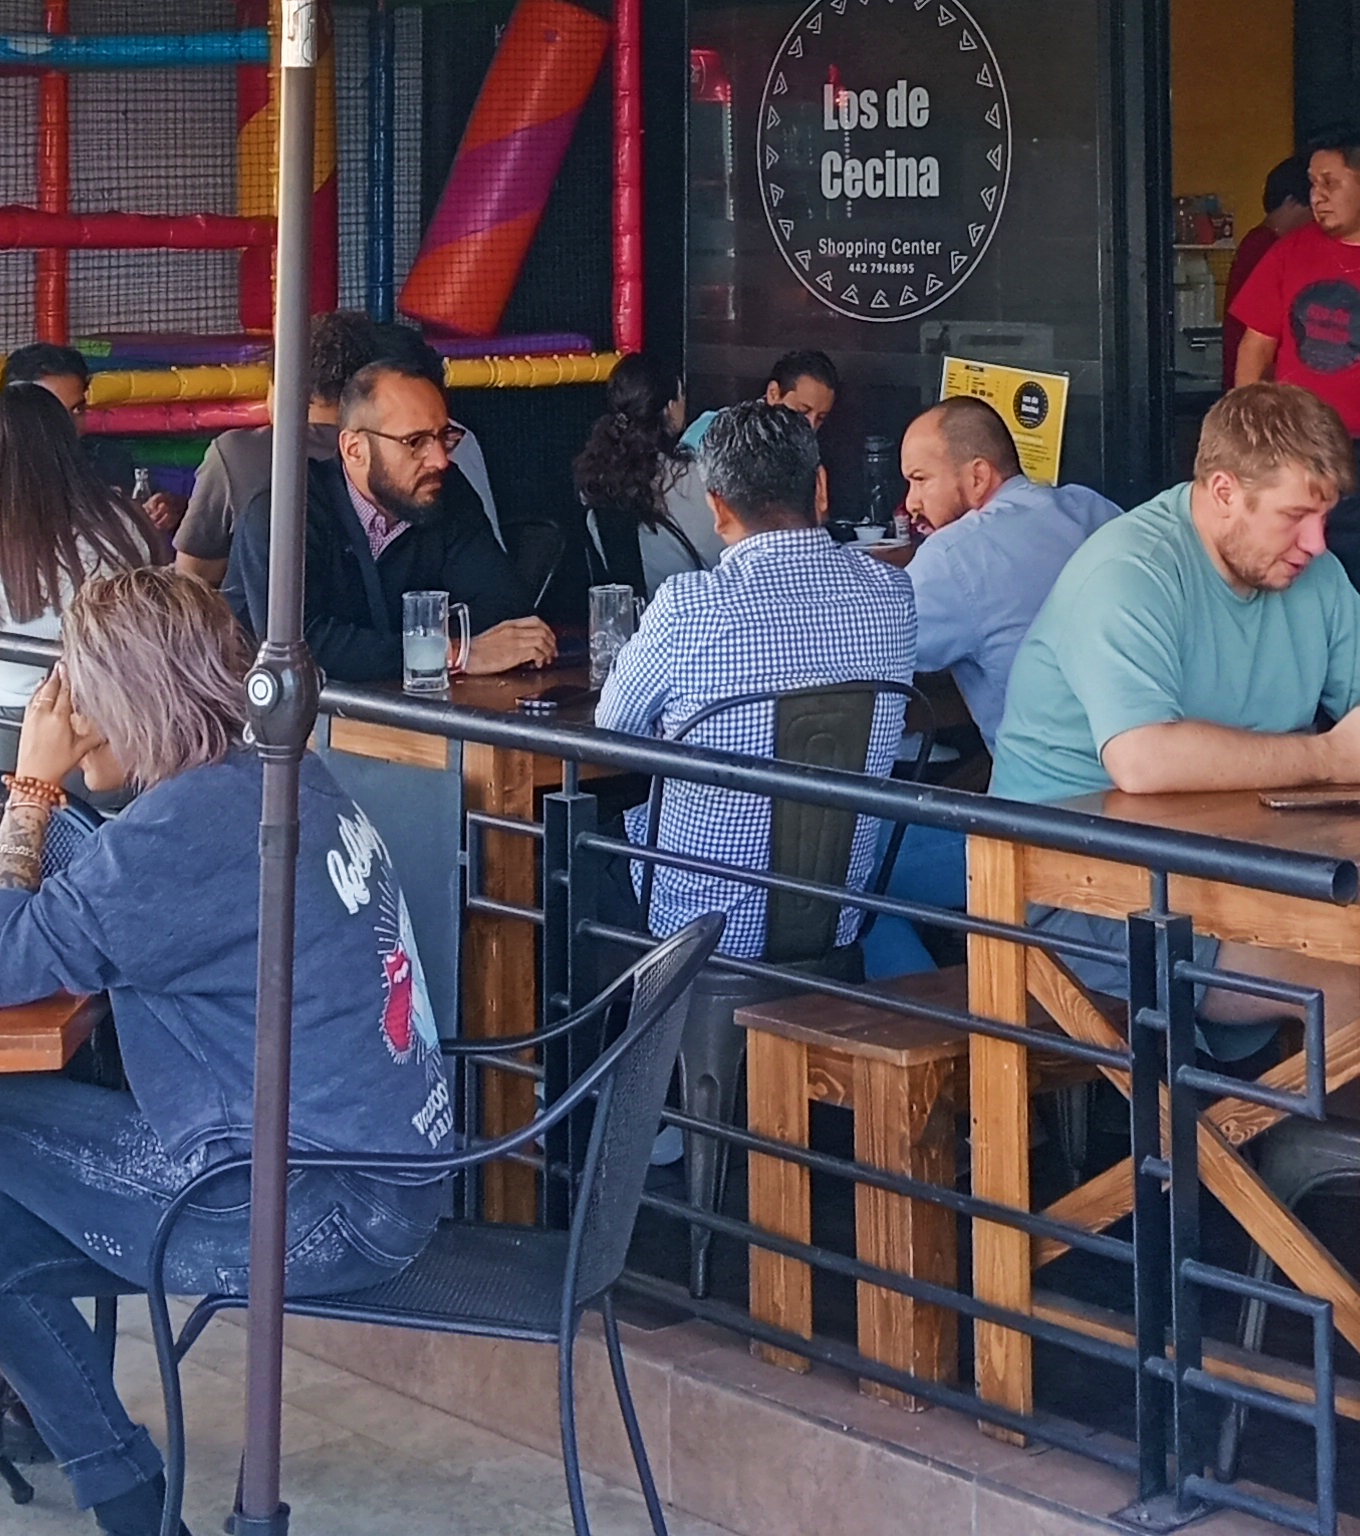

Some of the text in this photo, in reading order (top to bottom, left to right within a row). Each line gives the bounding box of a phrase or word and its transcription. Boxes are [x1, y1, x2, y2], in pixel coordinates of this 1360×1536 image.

[823, 80, 930, 131] Los de
[820, 150, 940, 200] Cecina
[818, 238, 942, 259] Shopping Center
[848, 262, 915, 275] 442 7948895
